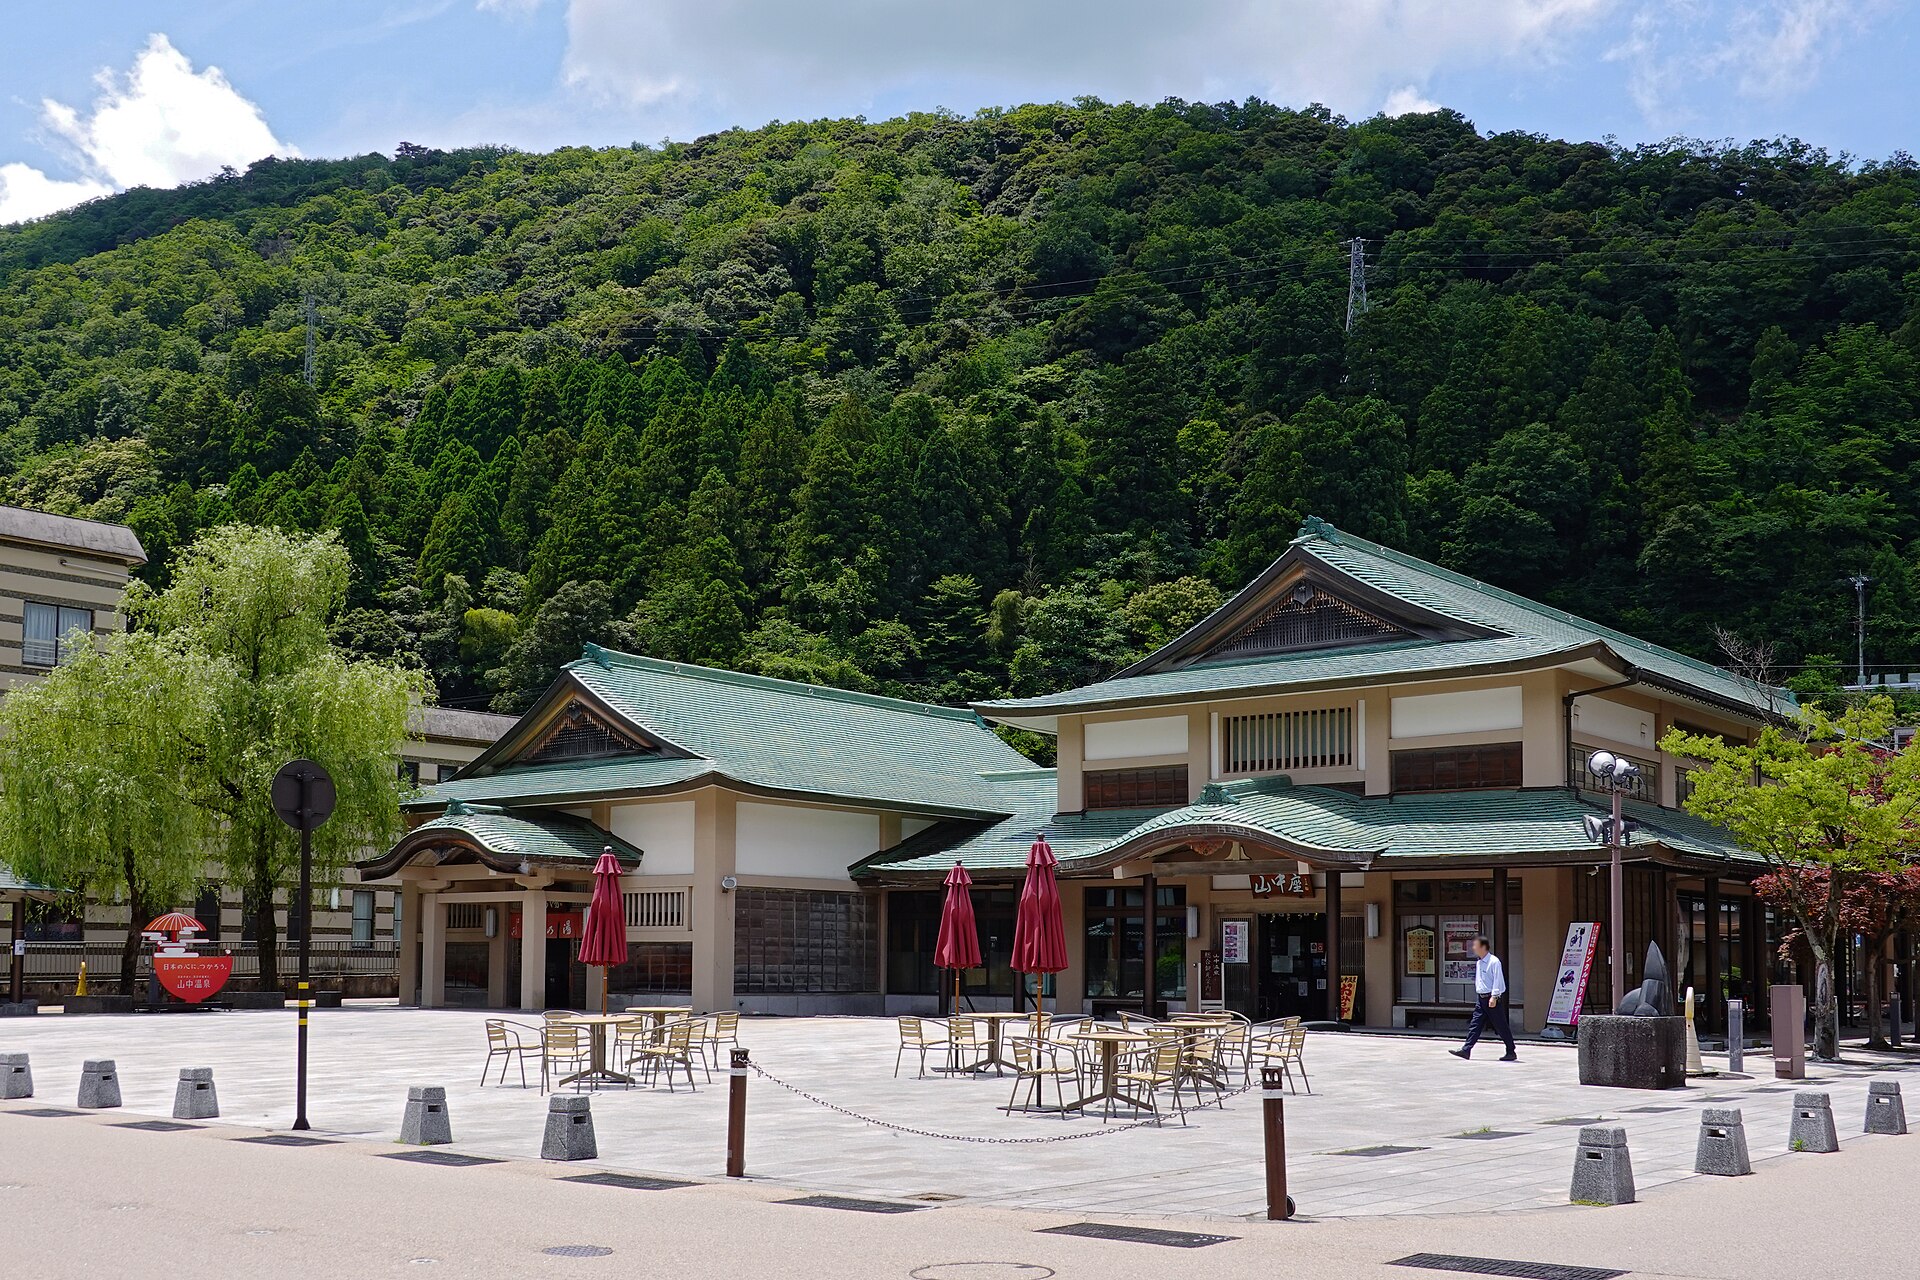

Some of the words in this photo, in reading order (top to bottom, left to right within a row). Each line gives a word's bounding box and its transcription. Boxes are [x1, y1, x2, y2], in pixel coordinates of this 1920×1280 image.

[1254, 873, 1304, 894] 山中座
[177, 979, 211, 989] 山中温泉
